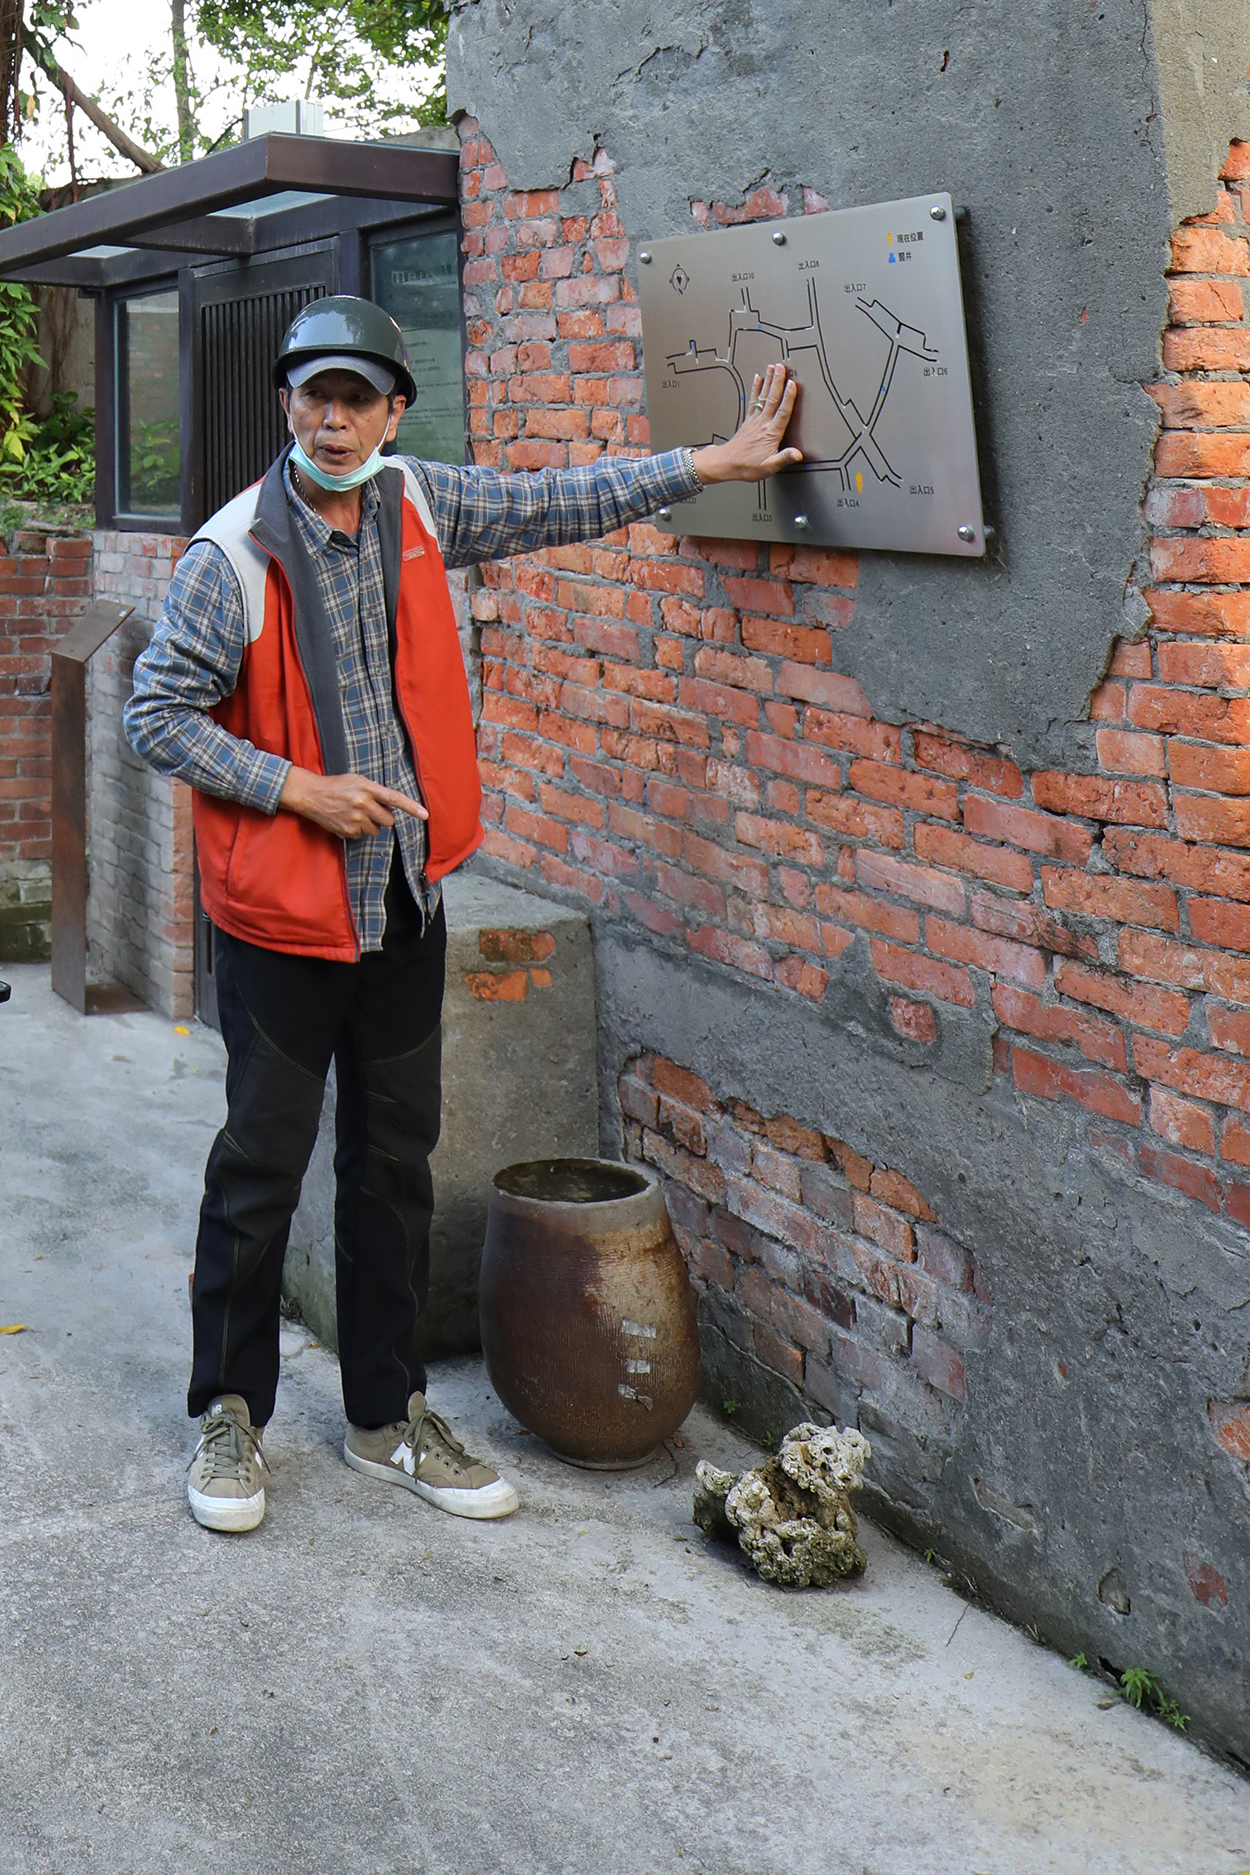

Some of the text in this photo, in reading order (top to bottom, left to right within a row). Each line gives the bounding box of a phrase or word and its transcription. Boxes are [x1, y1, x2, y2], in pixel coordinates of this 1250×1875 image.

[897, 231, 924, 244] 現在位置
[843, 283, 867, 293] 出入口7
[923, 366, 949, 377] 出入口6
[910, 484, 935, 495] 出入口5
[836, 497, 860, 508] 出入口4
